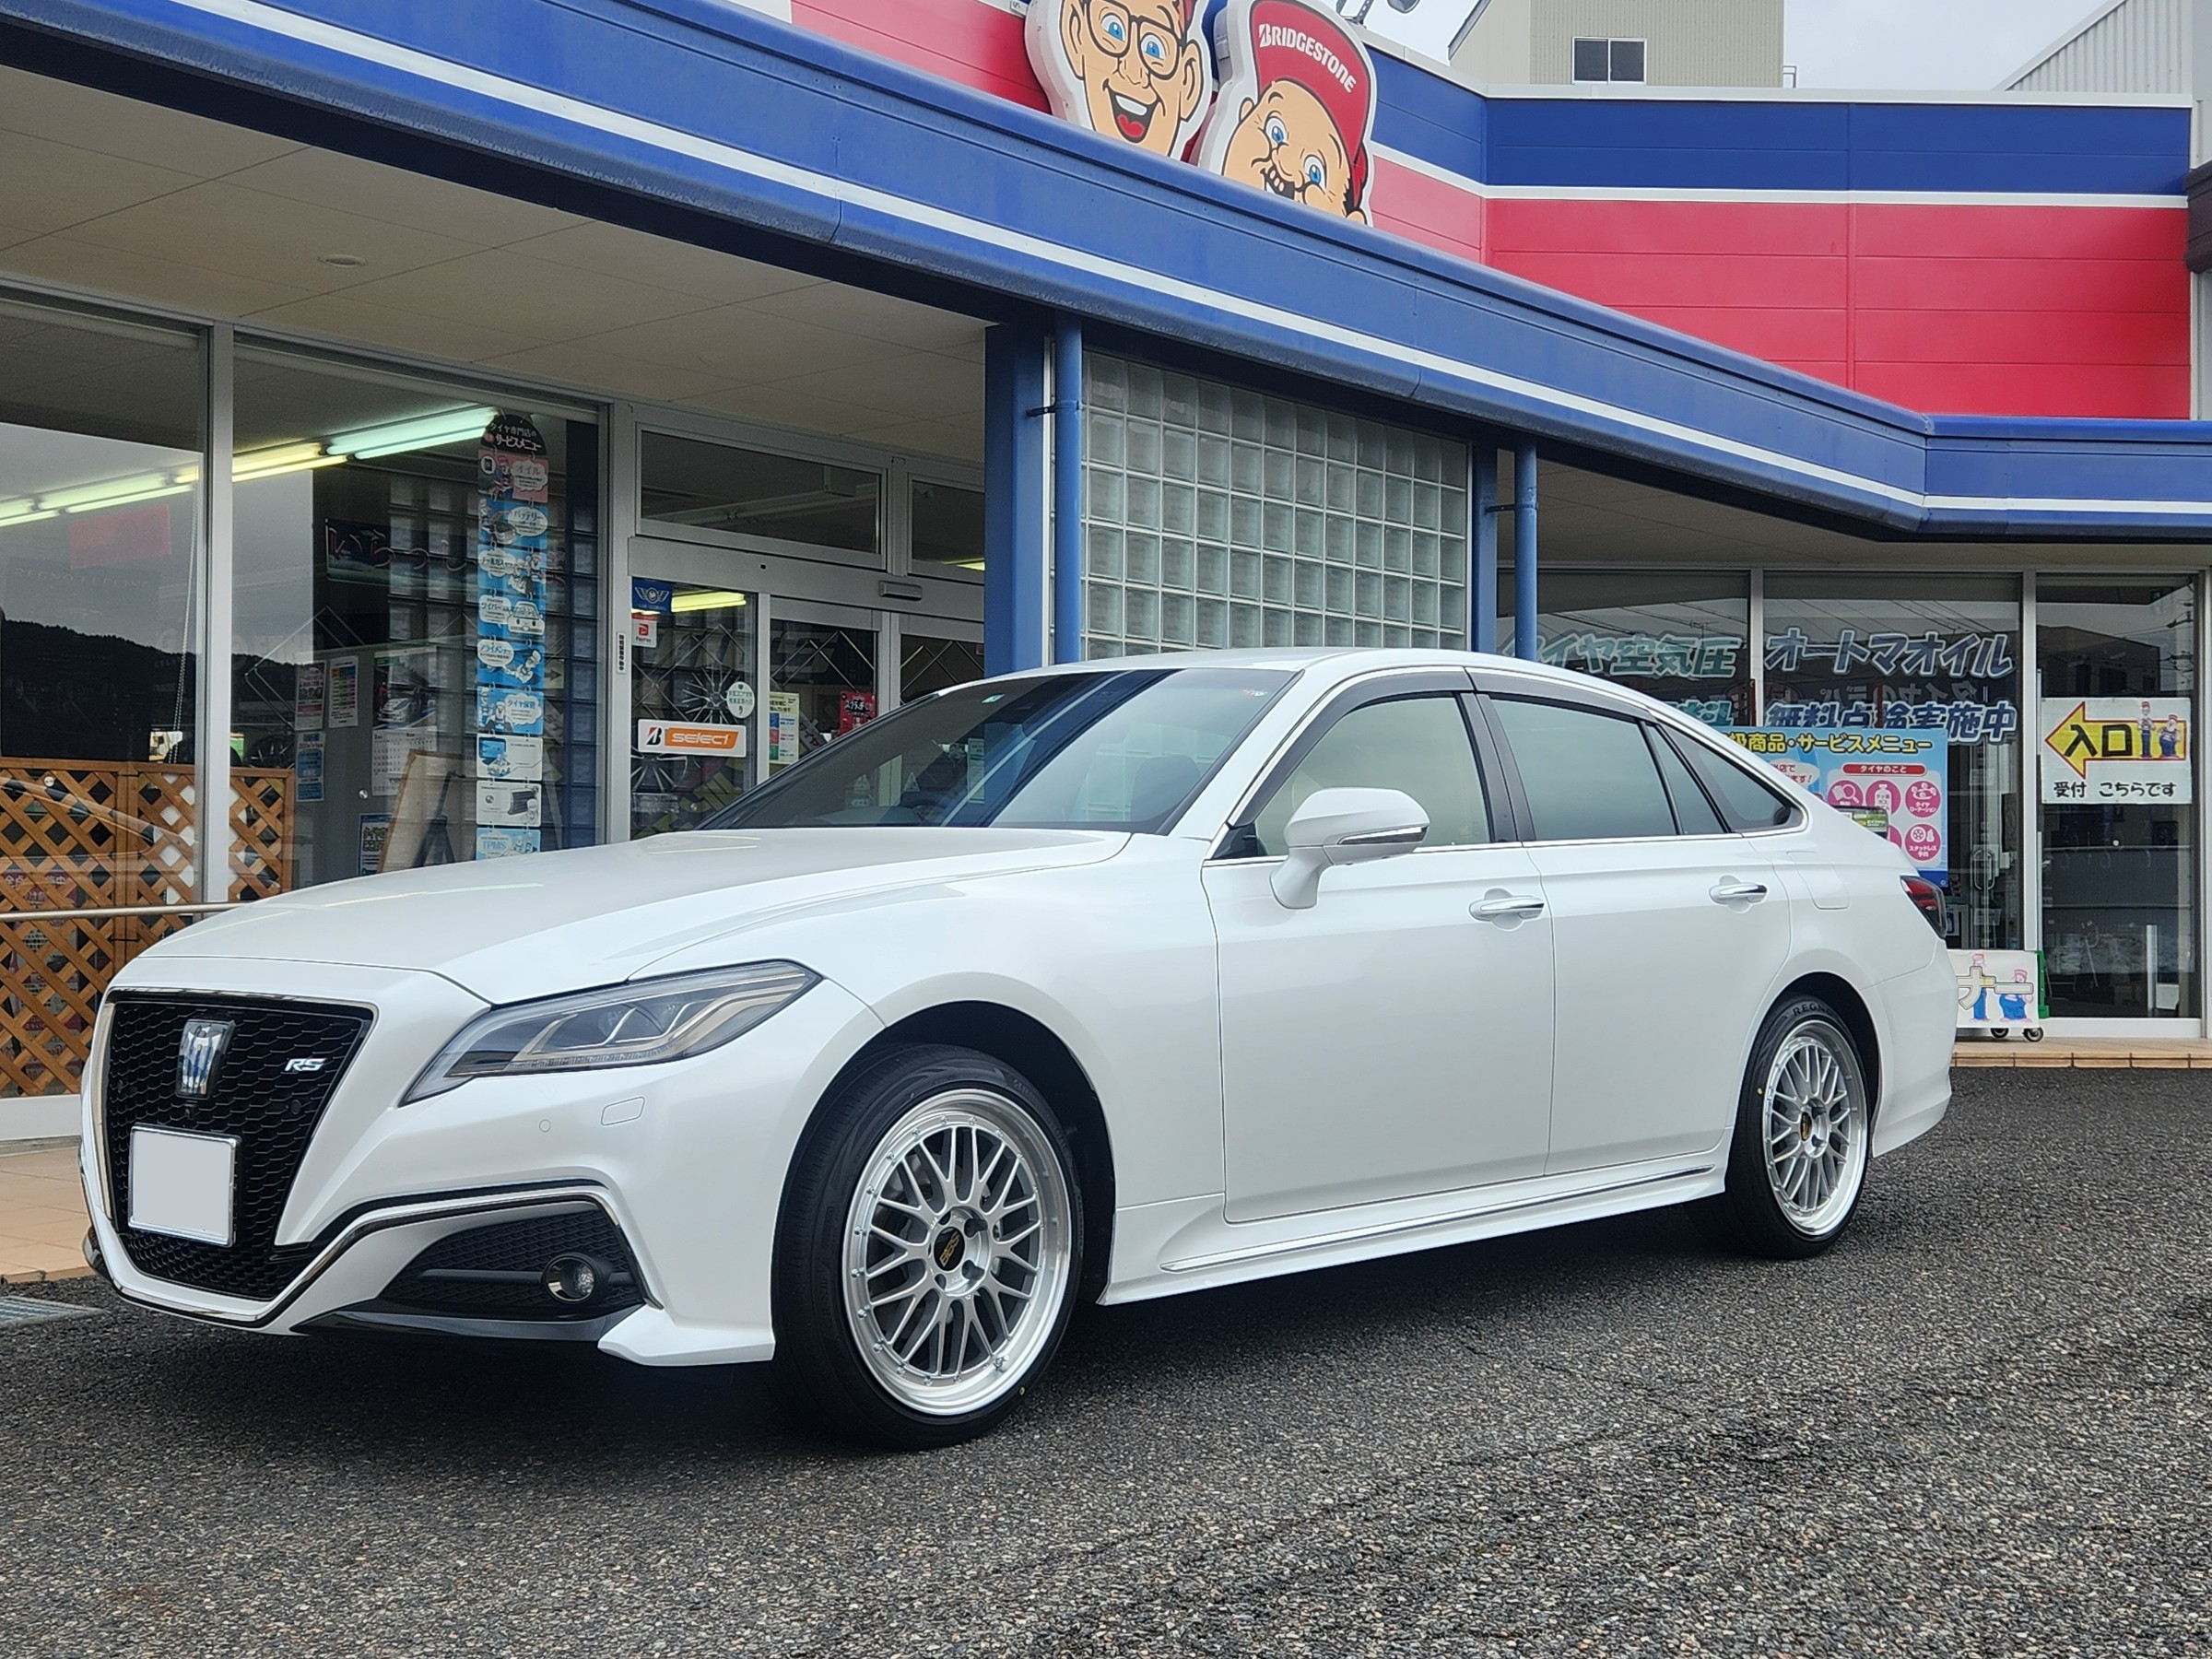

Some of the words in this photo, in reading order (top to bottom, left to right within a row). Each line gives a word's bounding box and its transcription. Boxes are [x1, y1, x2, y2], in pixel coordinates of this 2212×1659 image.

[1259, 23, 1357, 93] BRIDGESTONE
[515, 464, 540, 476] オイル
[1764, 627, 2015, 677] オートマオイル
[671, 732, 731, 746] select
[1725, 733, 1932, 753] 扱商品・サービスメニュー
[2065, 724, 2132, 757] 入口
[1859, 764, 1907, 774] タイヤのこと
[2053, 782, 2087, 798] 受付
[2100, 782, 2176, 798] こちらです
[285, 1057, 326, 1072] RS
[940, 1231, 959, 1266] BBS
